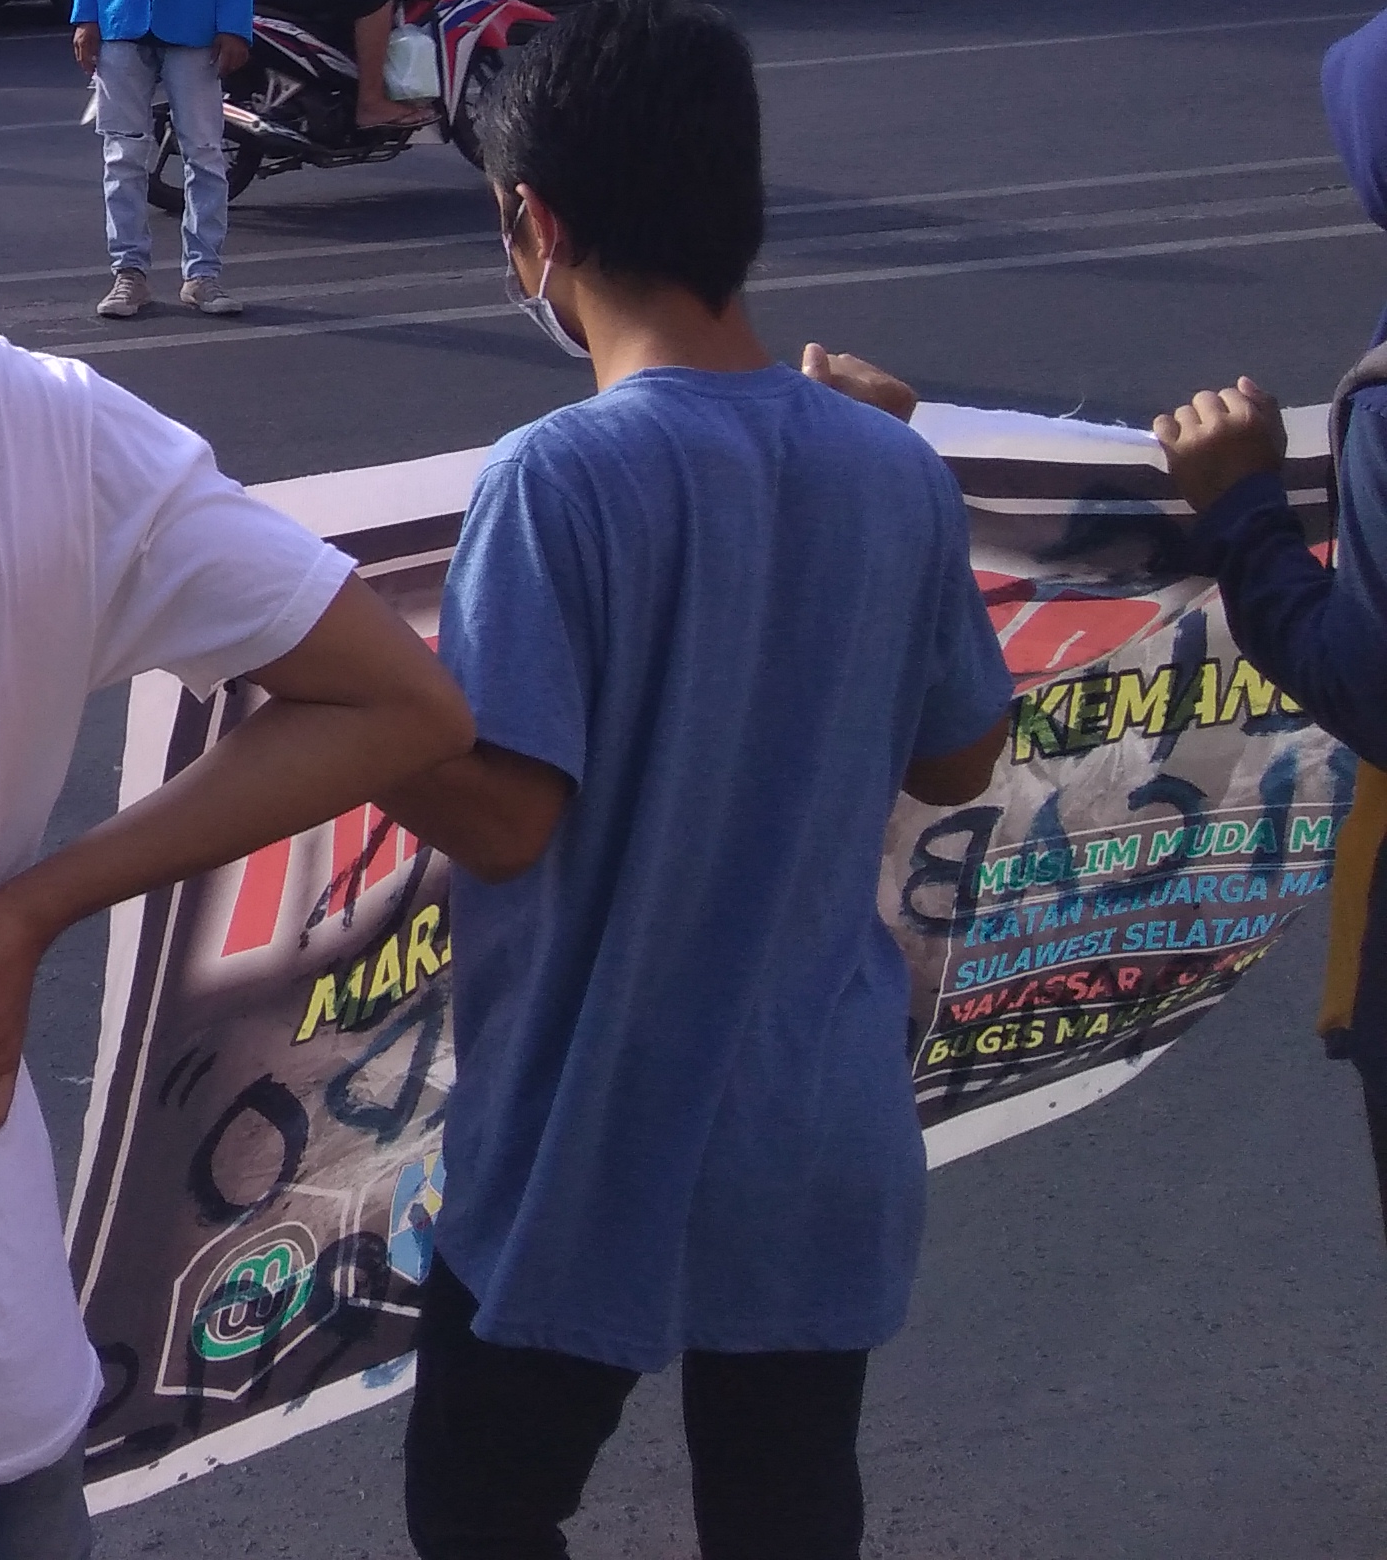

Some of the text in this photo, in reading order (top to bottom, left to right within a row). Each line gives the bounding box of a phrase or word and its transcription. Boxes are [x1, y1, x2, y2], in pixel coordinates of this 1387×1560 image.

[977, 834, 1142, 897] MUSLIM
[1146, 817, 1277, 866] MUDA
[955, 926, 1118, 990] SULAWESI
[1122, 911, 1277, 951] SELATAN
[964, 893, 1084, 948] IKATAN
[927, 1018, 1045, 1065] BUGIS
